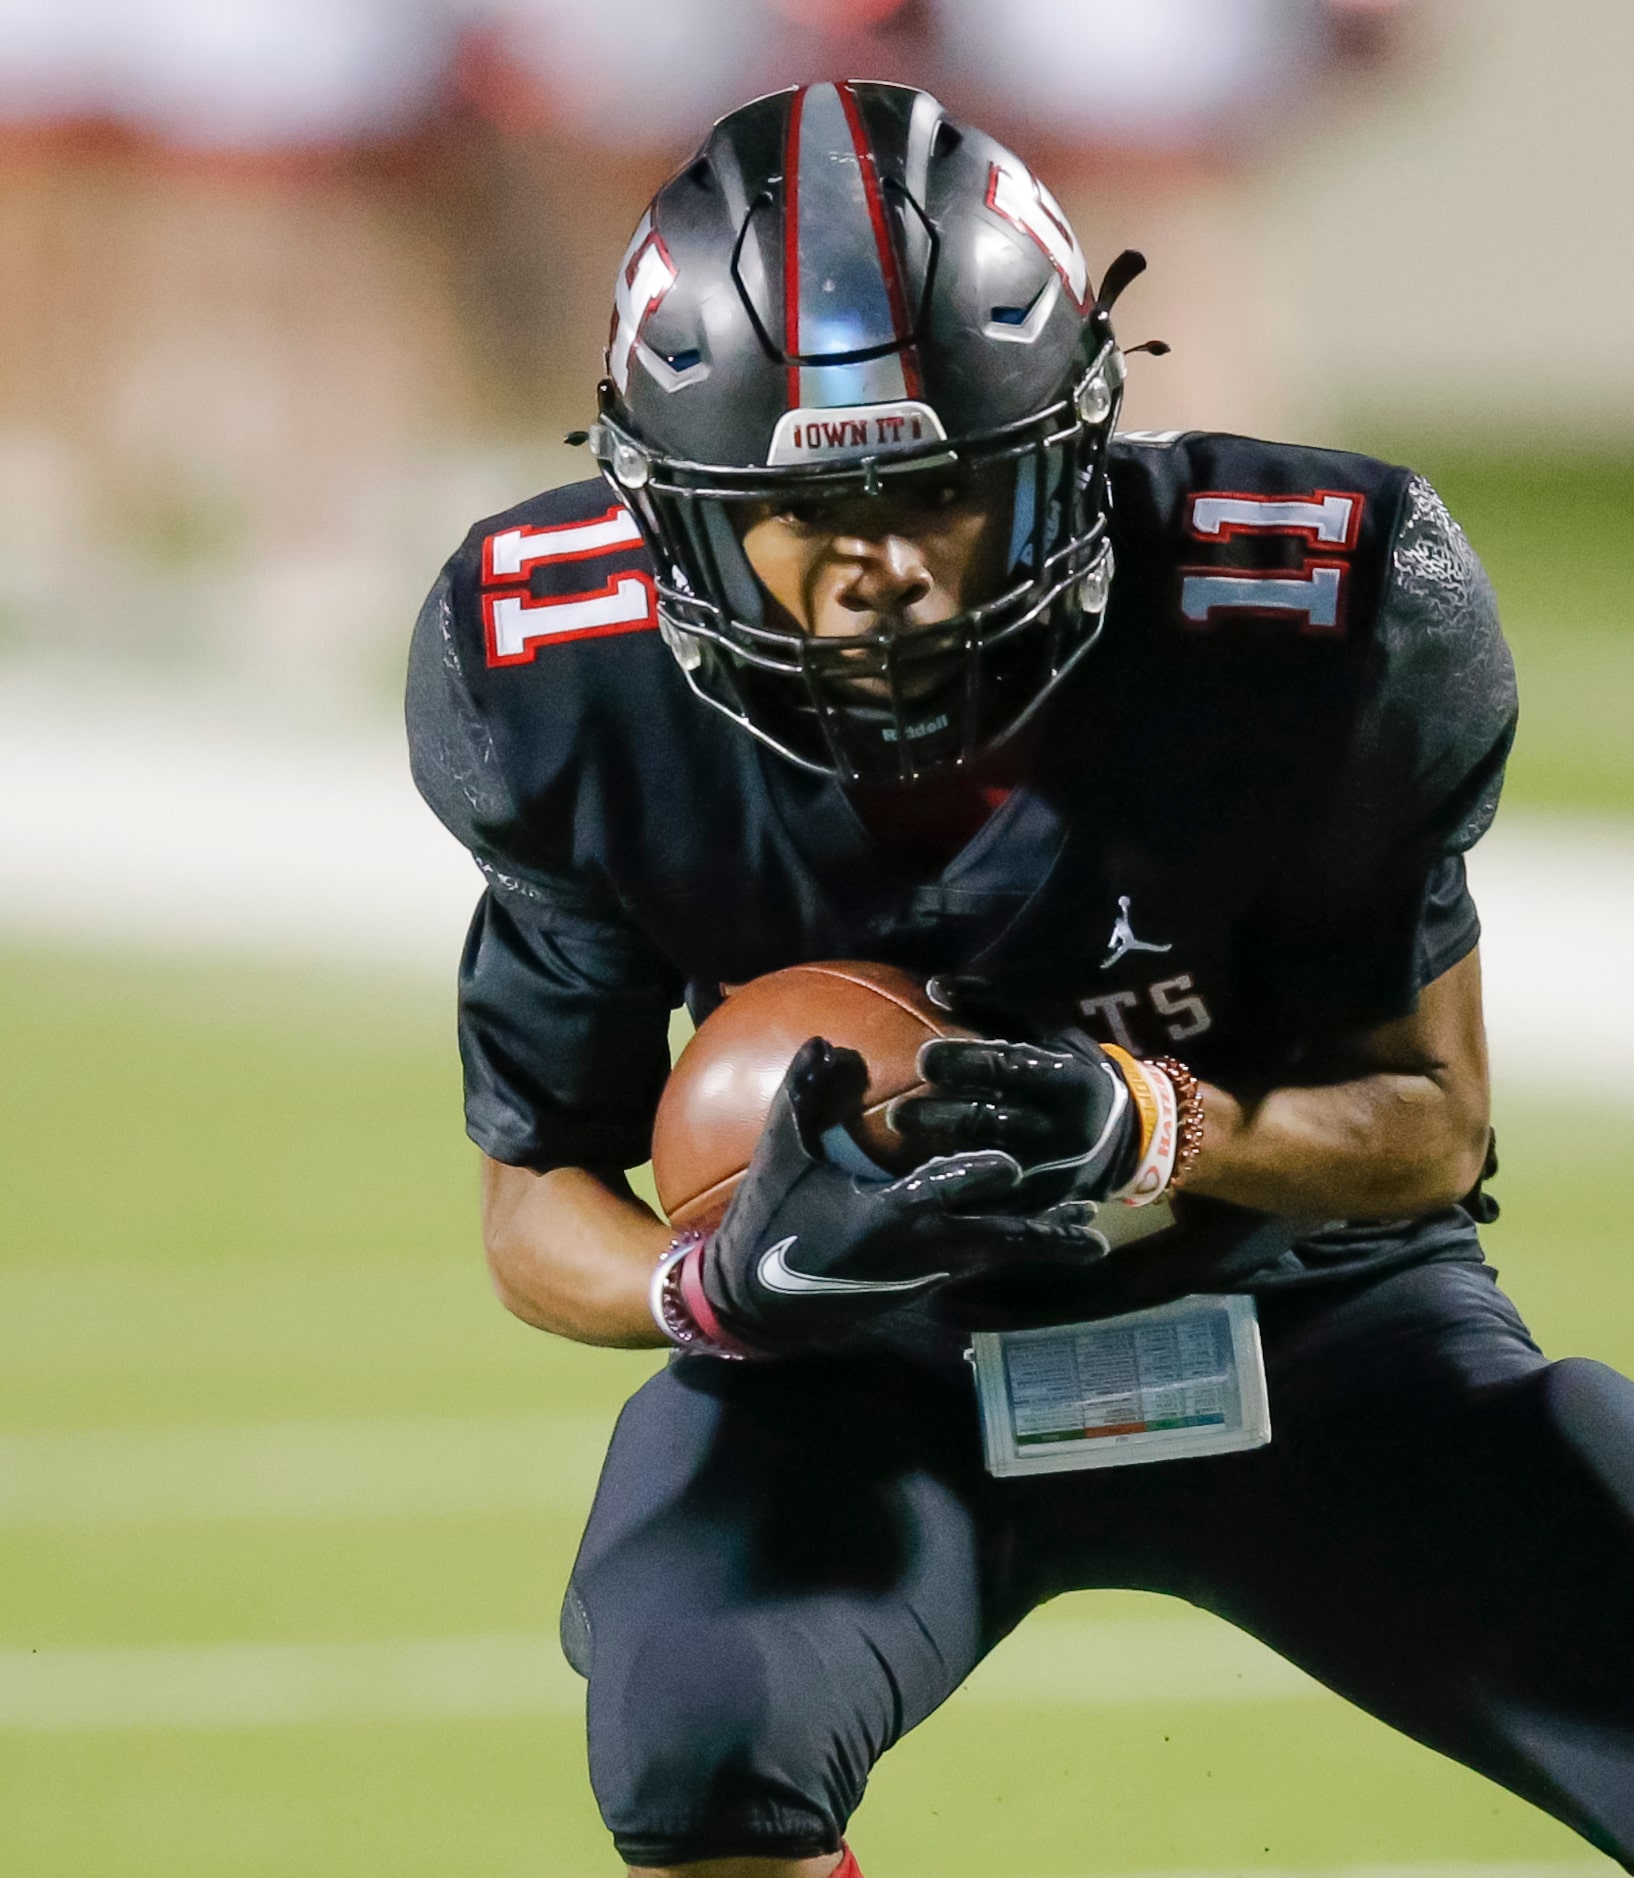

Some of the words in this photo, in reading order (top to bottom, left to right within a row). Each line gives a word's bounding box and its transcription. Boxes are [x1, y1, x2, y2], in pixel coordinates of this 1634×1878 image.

[806, 420, 868, 449] OWN
[875, 416, 905, 444] IT
[482, 504, 659, 669] 11
[1178, 489, 1366, 636] 11
[881, 713, 949, 742] Rddell
